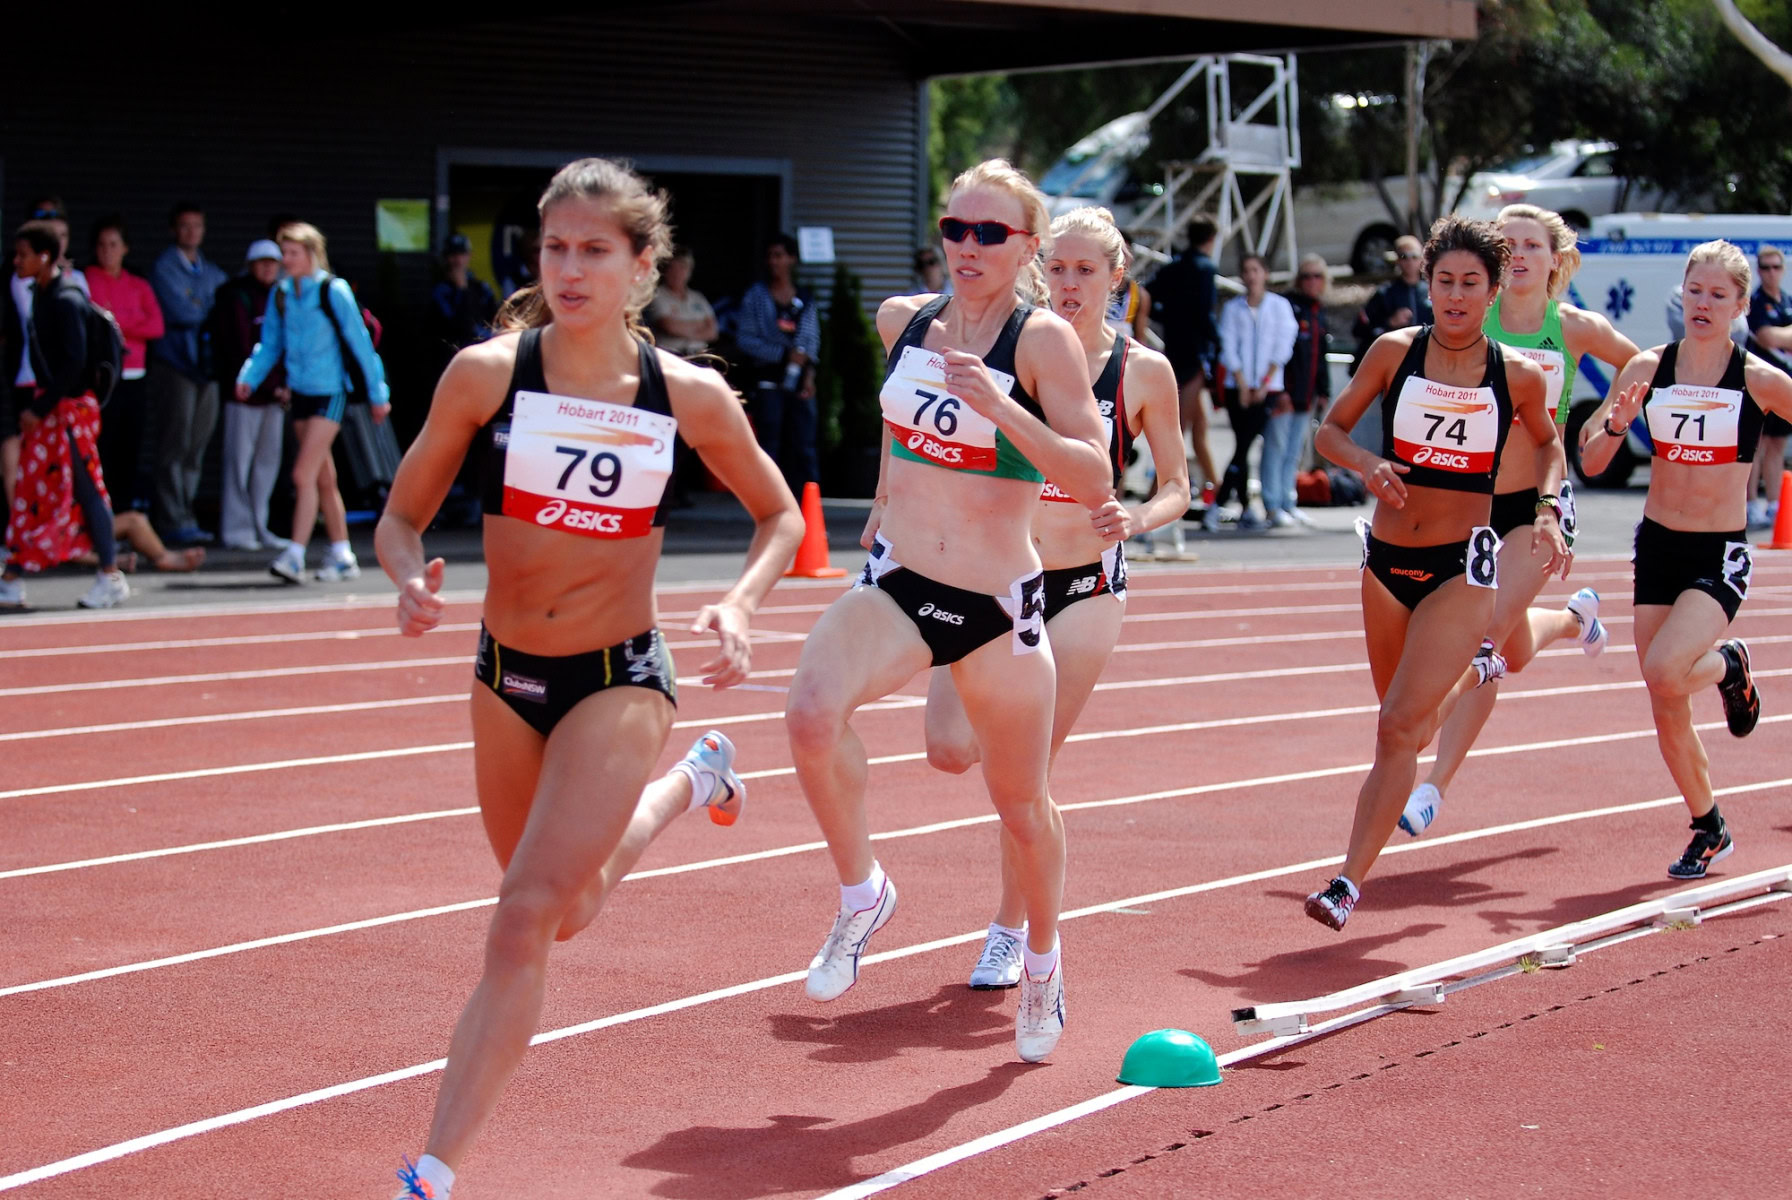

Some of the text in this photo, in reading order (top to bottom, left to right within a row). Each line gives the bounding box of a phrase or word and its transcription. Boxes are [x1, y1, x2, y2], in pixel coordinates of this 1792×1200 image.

[1096, 398, 1115, 416] B
[1426, 384, 1478, 400] Hobart 2011
[1671, 387, 1719, 399] Hobart 2011
[556, 402, 640, 427] Hobart 2011
[913, 389, 960, 436] 76
[1671, 412, 1705, 441] 71
[1423, 413, 1467, 446] 74
[555, 445, 623, 498] 79
[1390, 567, 1424, 577] saucony
[1471, 528, 1496, 586] 8
[1727, 546, 1751, 596] 2
[1017, 571, 1044, 647] 5
